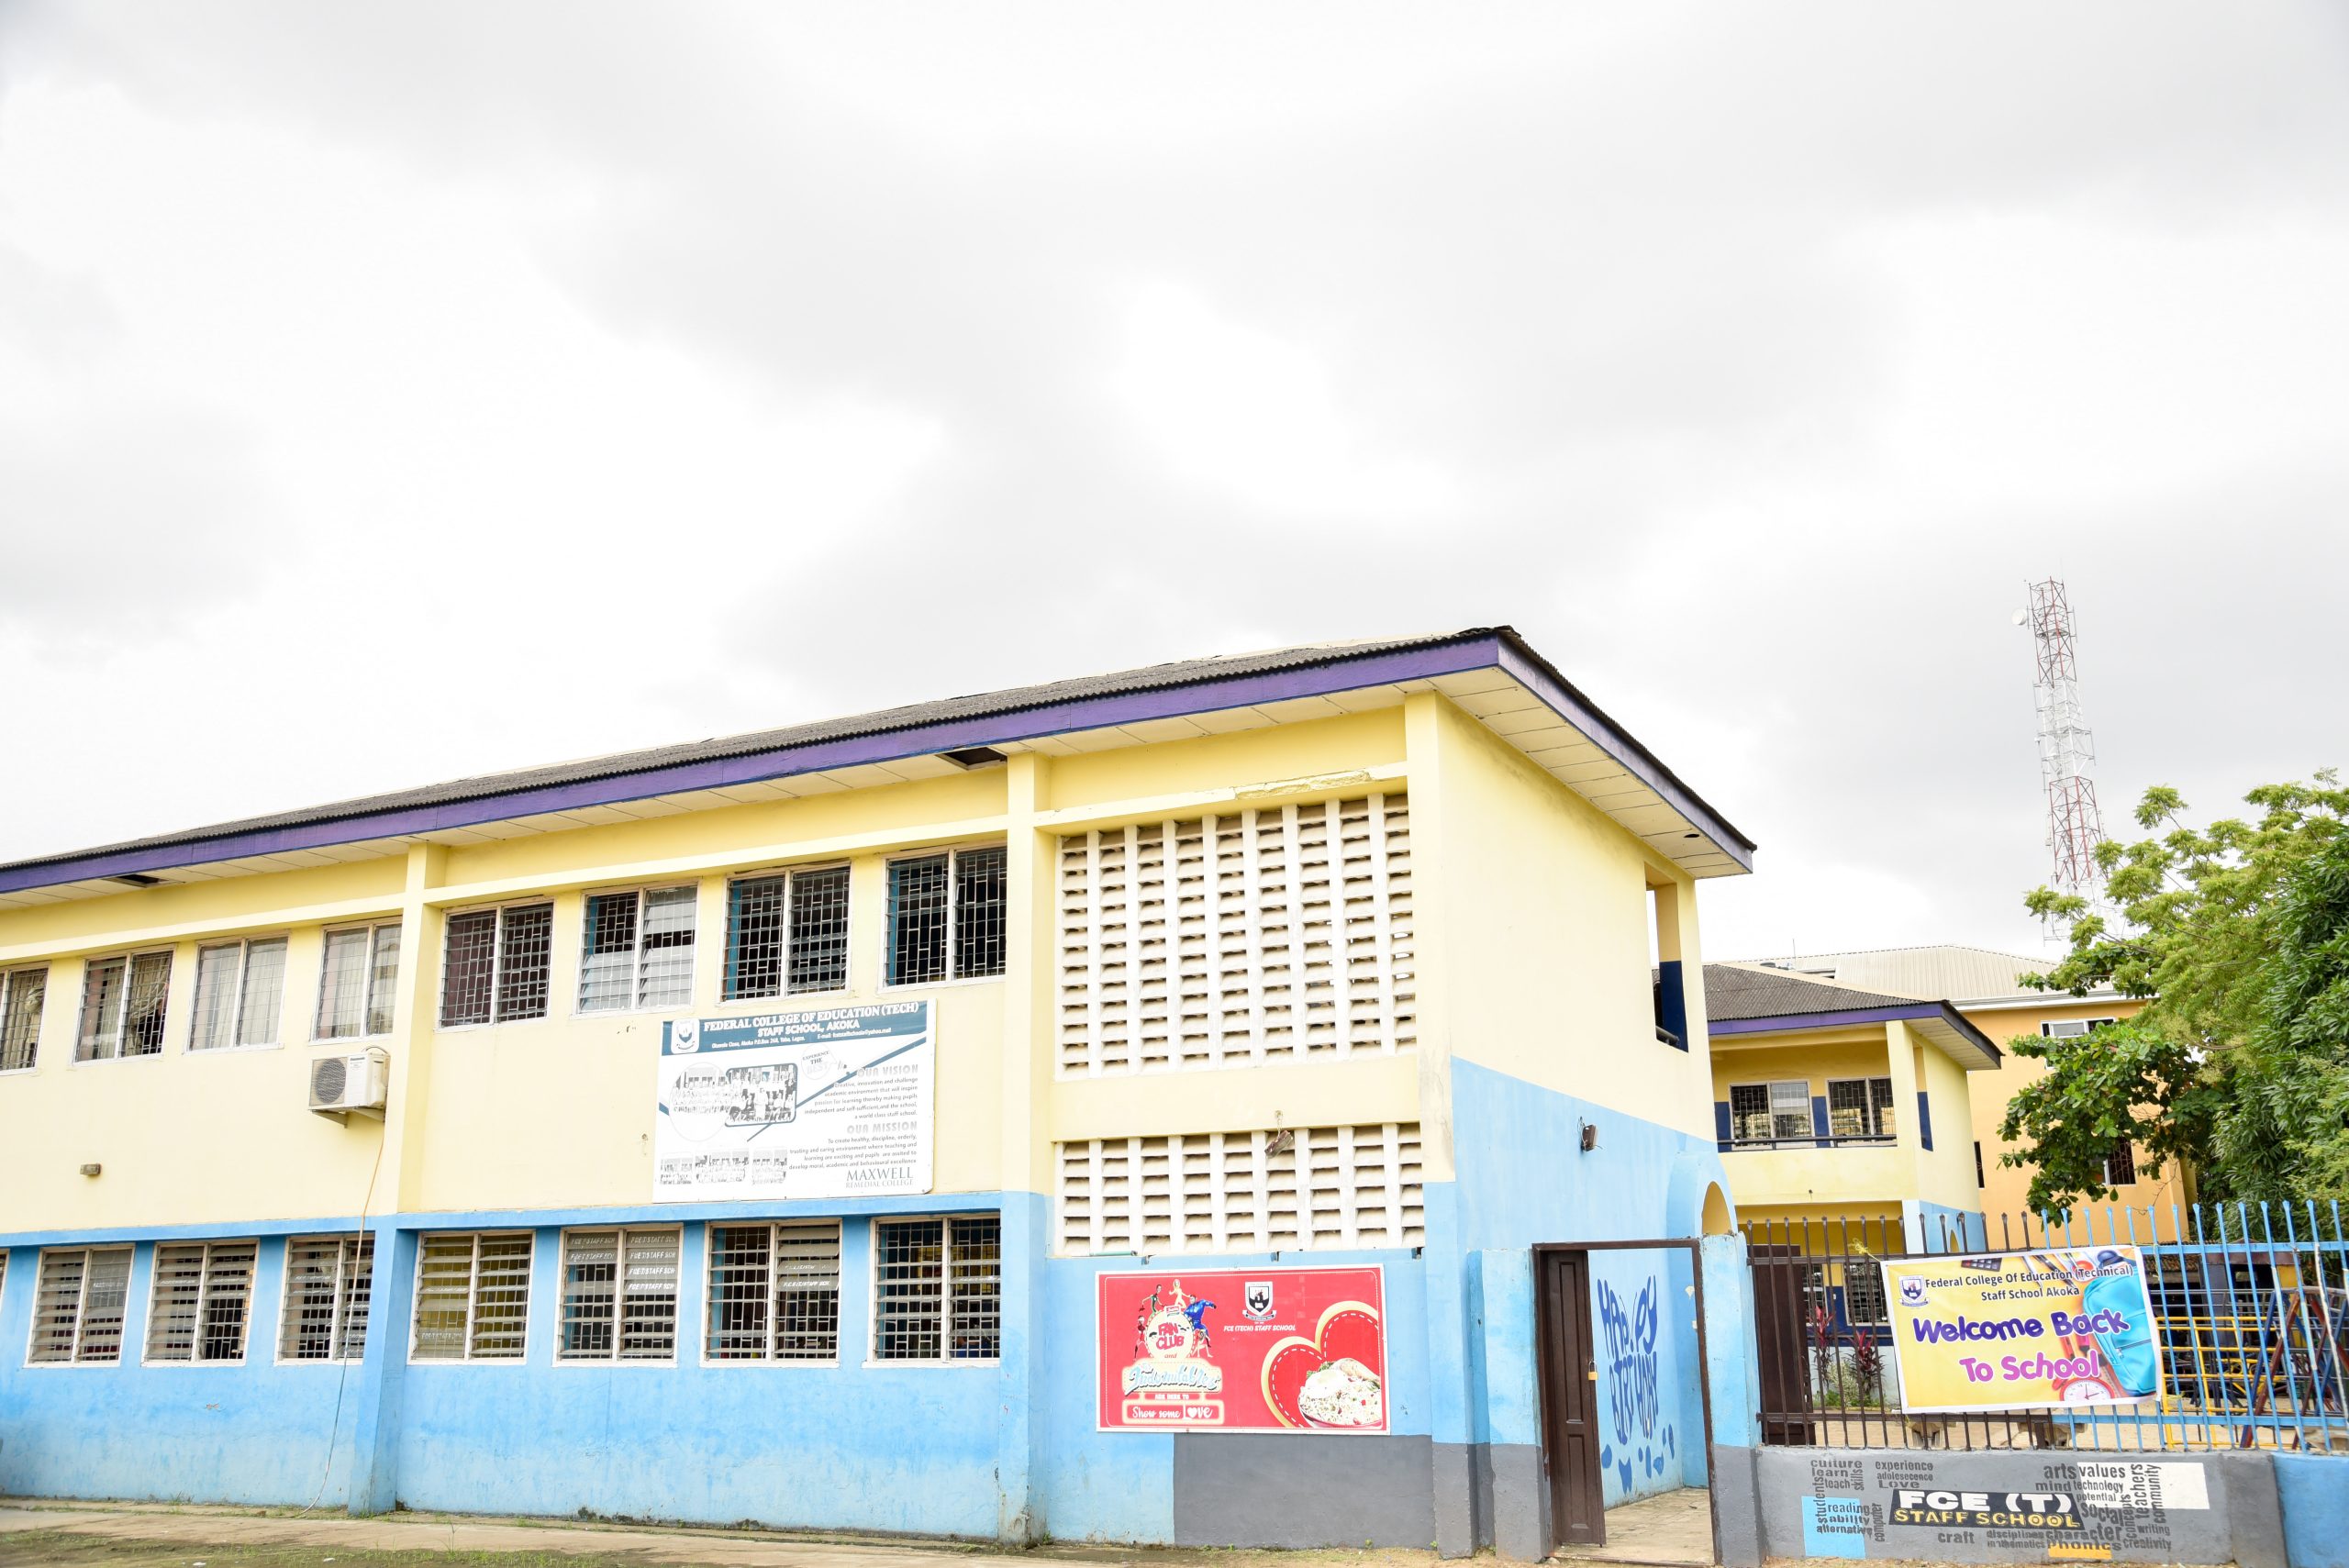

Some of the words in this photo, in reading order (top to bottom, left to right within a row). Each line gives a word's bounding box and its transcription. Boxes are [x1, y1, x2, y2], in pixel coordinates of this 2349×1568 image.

[704, 1018, 751, 1032] FEDERAL
[752, 1013, 800, 1028] COLLEGE
[801, 1012, 817, 1023] OF
[817, 1006, 881, 1021] EDUCATION
[881, 1001, 919, 1017] (TECH)
[757, 1026, 785, 1038] STAFF
[785, 1022, 825, 1035] SCHOOL,
[826, 1018, 861, 1031] AKOKA
[802, 1051, 830, 1061] EXPERIENCE
[857, 1067, 879, 1077] OUR
[882, 1064, 918, 1074] VISION
[847, 1124, 869, 1134] OUR
[872, 1121, 918, 1133] MISSION
[846, 1166, 914, 1182] MAXWELL
[845, 1180, 881, 1188] REMEDIAL
[882, 1178, 913, 1187] COLLEGE
[1925, 1276, 1963, 1289] Federal
[1966, 1273, 2003, 1287] College
[2006, 1273, 2018, 1283] Of
[2021, 1270, 2073, 1283] Education
[2075, 1264, 2133, 1281] (Technical)
[1981, 1289, 2007, 1301] Staff
[2009, 1287, 2043, 1299] School
[2046, 1285, 2080, 1297] Akoka
[1158, 1322, 1179, 1336] FAN
[1912, 1315, 2044, 1344] Welcome
[2050, 1307, 2131, 1338] Back
[1156, 1335, 1185, 1351] CLUB
[1959, 1356, 1994, 1383] To
[2000, 1349, 2100, 1382] School
[1132, 1406, 1157, 1418] Show
[1158, 1409, 1182, 1419] some
[1810, 1459, 1863, 1468] culture
[1875, 1460, 1933, 1472] experience
[2043, 1462, 2077, 1480] arts
[2078, 1462, 2126, 1478] values
[1811, 1468, 1849, 1477] learn
[1850, 1468, 1865, 1491] skills
[1824, 1478, 1851, 1490] teach
[1878, 1479, 1920, 1488] Love
[2035, 1480, 2072, 1492] mind
[2073, 1479, 2123, 1494] technology
[2130, 1463, 2150, 1519] teachers
[1812, 1476, 1828, 1524] students
[2076, 1492, 2117, 1502] potential
[2143, 1463, 2167, 1524] community
[1828, 1503, 1870, 1516] reading
[1898, 1490, 1991, 1512] FCE
[2005, 1493, 2072, 1514] (T)
[1829, 1515, 1870, 1526] ability
[1872, 1502, 1887, 1542] computer
[1894, 1507, 1969, 1524] STAFF
[1976, 1511, 2082, 1529] SCHOOL
[2120, 1494, 2137, 1540] concepts
[1816, 1523, 1874, 1539] alternative
[1937, 1530, 1976, 1544] craft
[1986, 1529, 2044, 1540] disciplines
[2045, 1522, 2122, 1541] character
[2136, 1523, 2171, 1537] writing
[1986, 1539, 2046, 1549] mathematics
[2047, 1540, 2122, 1551] Phonics
[2122, 1537, 2172, 1552] creativity
